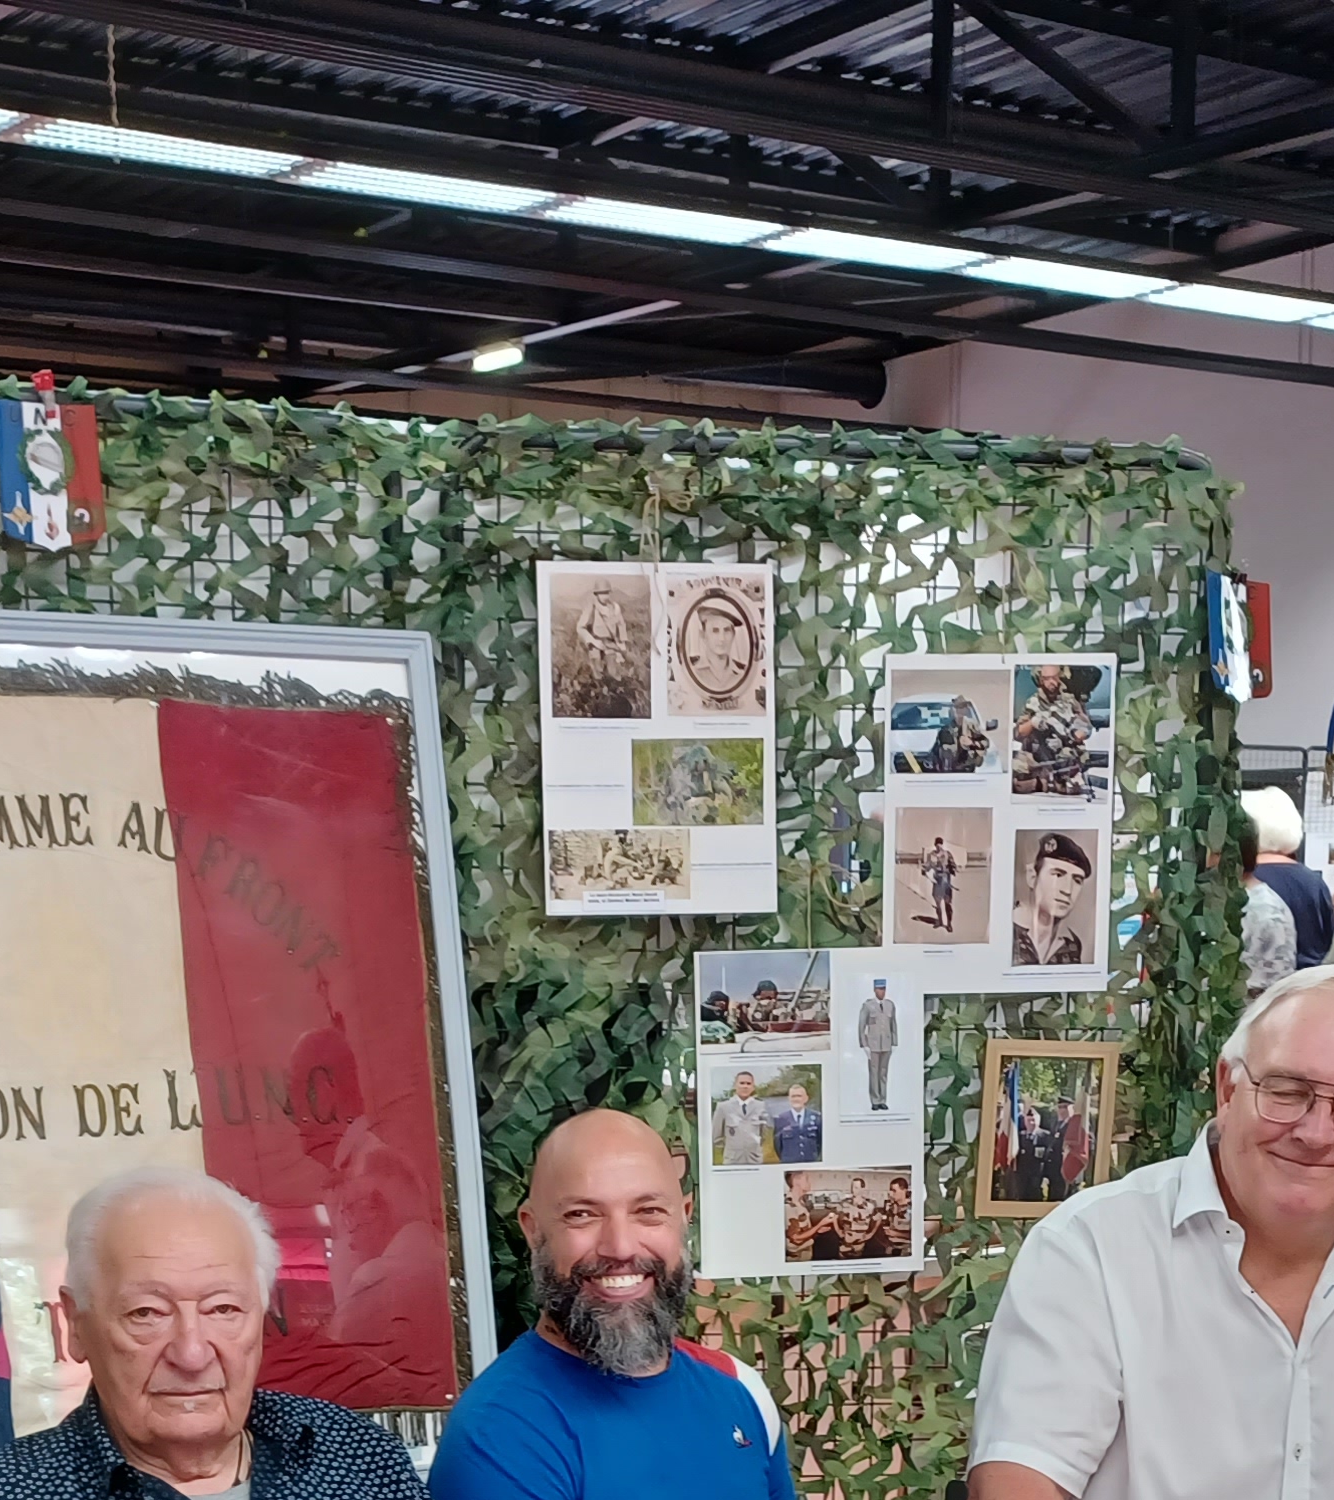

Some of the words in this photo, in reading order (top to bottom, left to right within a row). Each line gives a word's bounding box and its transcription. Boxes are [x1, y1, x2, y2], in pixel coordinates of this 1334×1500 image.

[118, 801, 184, 865] AU
[194, 833, 343, 973] FRONT
[72, 1082, 144, 1138] DE
